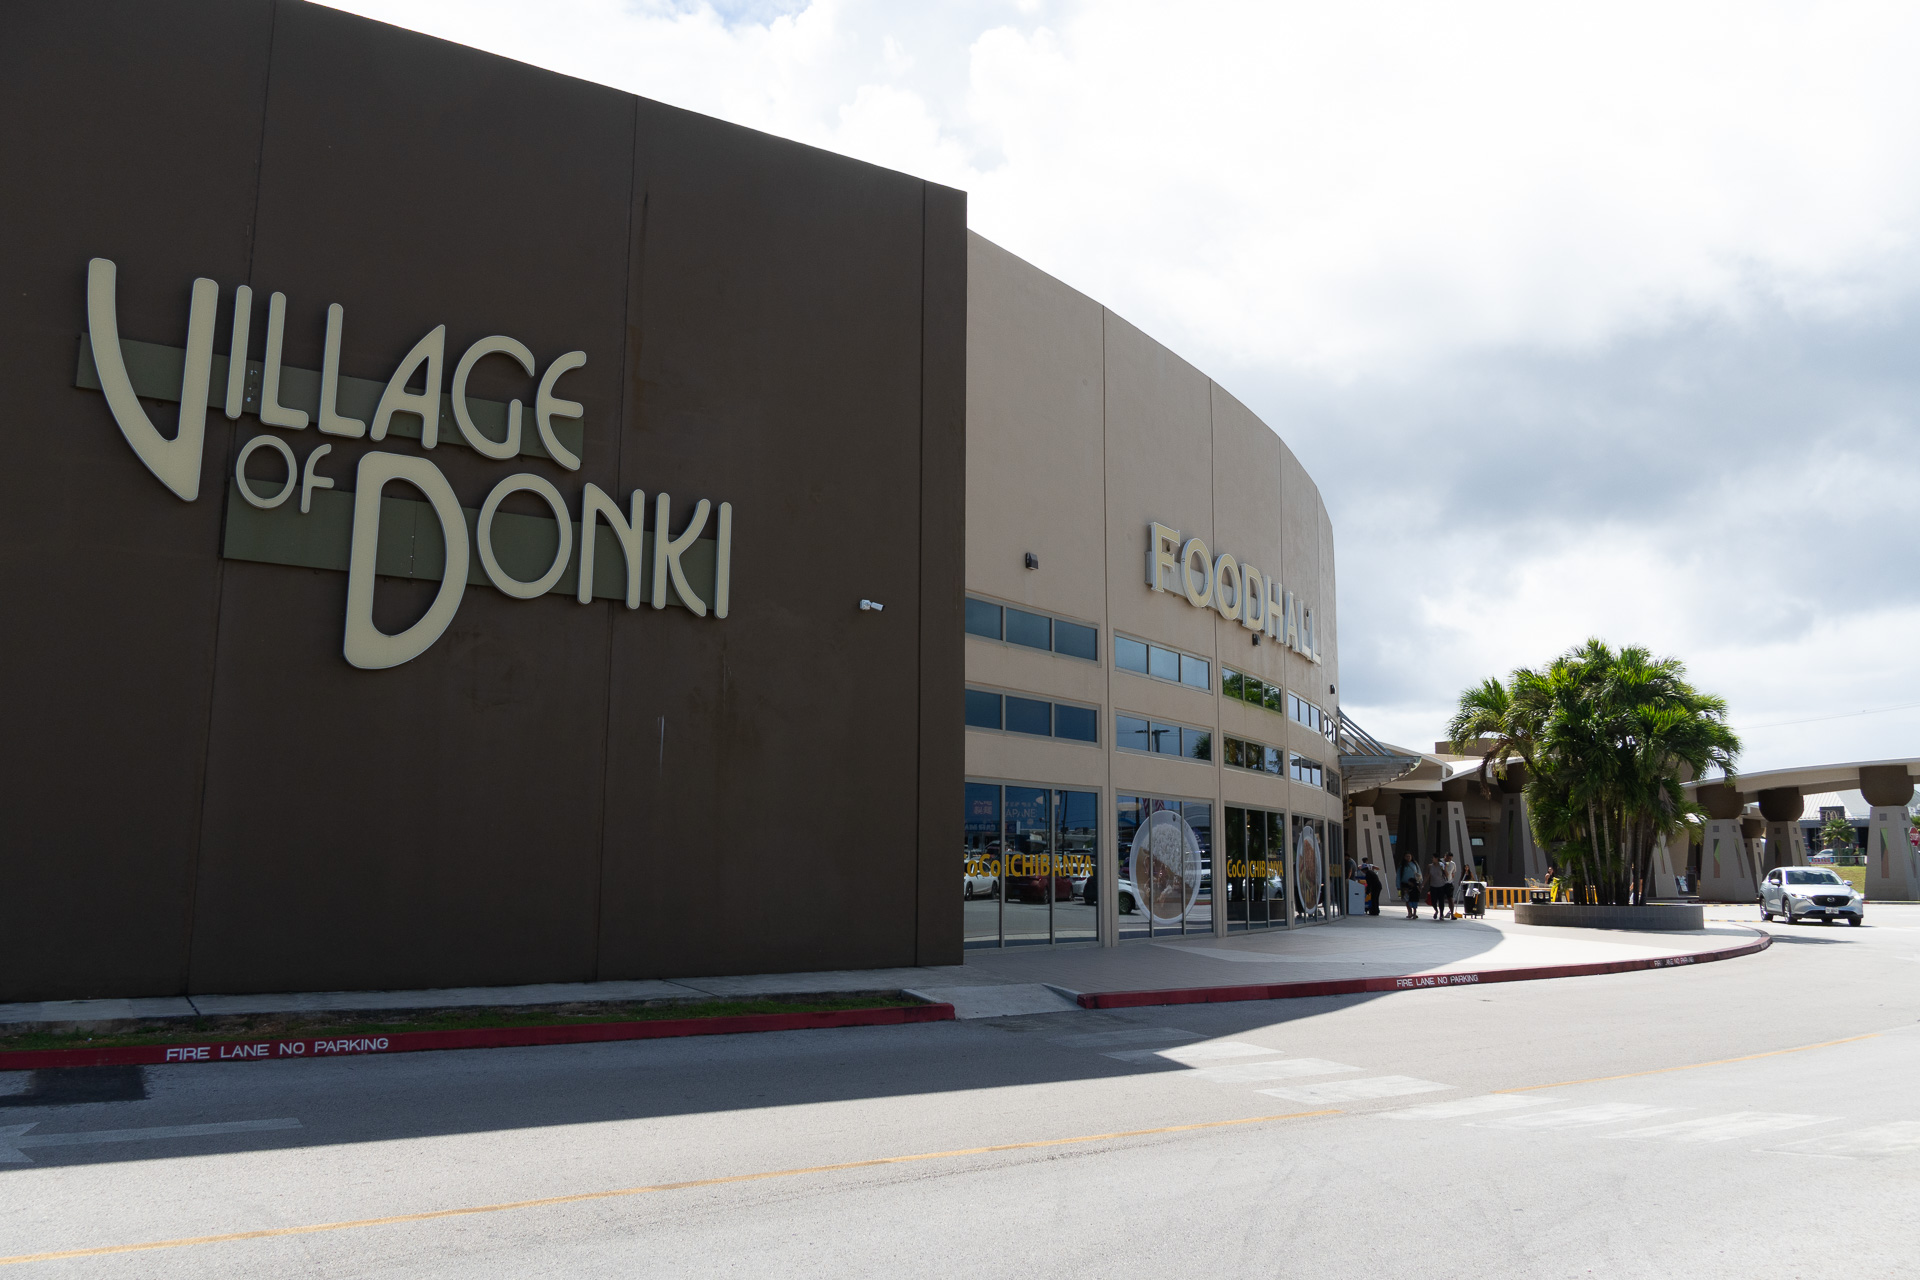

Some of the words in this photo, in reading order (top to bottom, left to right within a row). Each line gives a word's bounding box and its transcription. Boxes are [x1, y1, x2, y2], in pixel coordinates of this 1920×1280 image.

[87, 258, 587, 502] VILLAGE
[235, 435, 334, 513] OF
[344, 451, 732, 669] DONKI
[964, 853, 1001, 877] oCo
[1005, 854, 1093, 877] ICHIBANYA
[1227, 859, 1246, 878] CoCo
[1396, 978, 1414, 987] FIRE
[1416, 977, 1435, 986] LANE
[1437, 976, 1448, 985] NO
[1450, 974, 1479, 983] PARKING
[166, 1047, 211, 1061] FIRE
[220, 1044, 270, 1058] LANE
[279, 1042, 305, 1055] NO
[314, 1037, 389, 1053] PARKING
